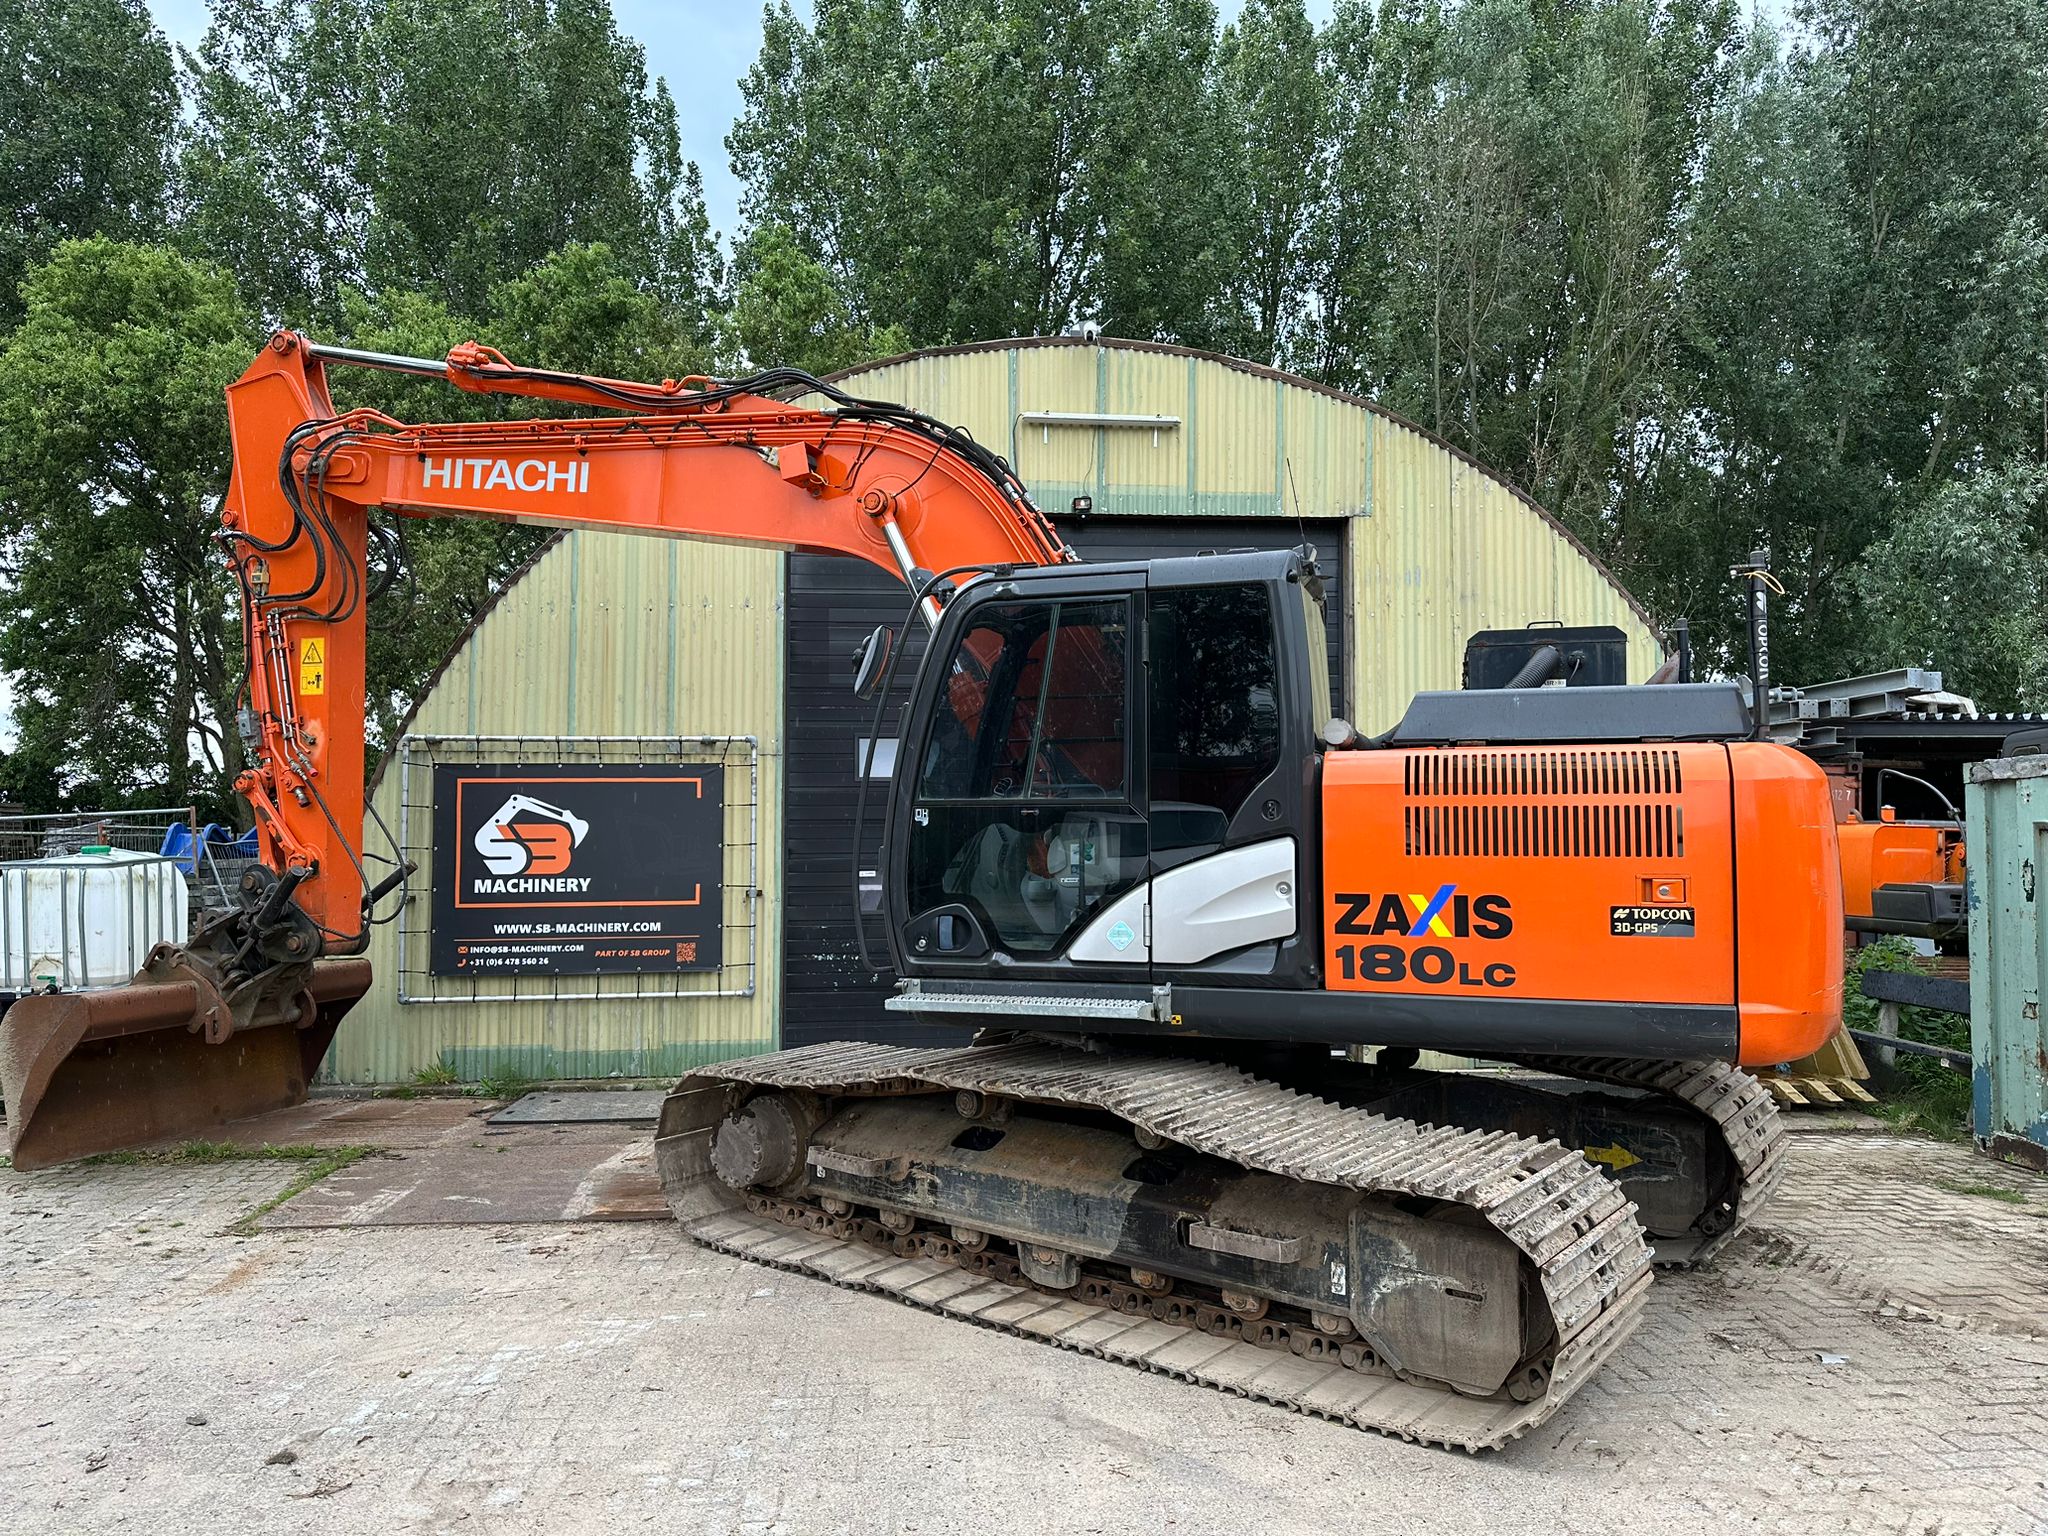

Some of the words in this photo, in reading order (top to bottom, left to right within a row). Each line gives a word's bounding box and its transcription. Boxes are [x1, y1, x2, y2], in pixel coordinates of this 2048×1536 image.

[423, 457, 590, 493] HITACHI
[474, 812, 573, 875] SB
[474, 878, 592, 894] MACHINERY
[1334, 885, 1514, 940] ZAXIS
[1631, 908, 1692, 921] TOPCON
[493, 922, 662, 935] WWW.SB-MACHINERY.COM
[1613, 922, 1659, 934] 3D-GPS
[470, 945, 584, 954] INFO@SB-MACHINERY.COM
[629, 949, 641, 957] SB
[469, 959, 484, 967] +31
[485, 958, 503, 967] (0)6
[504, 958, 520, 966] 478
[521, 957, 537, 966] 560
[538, 957, 549, 965] 26
[1335, 944, 1517, 987] 180LC
